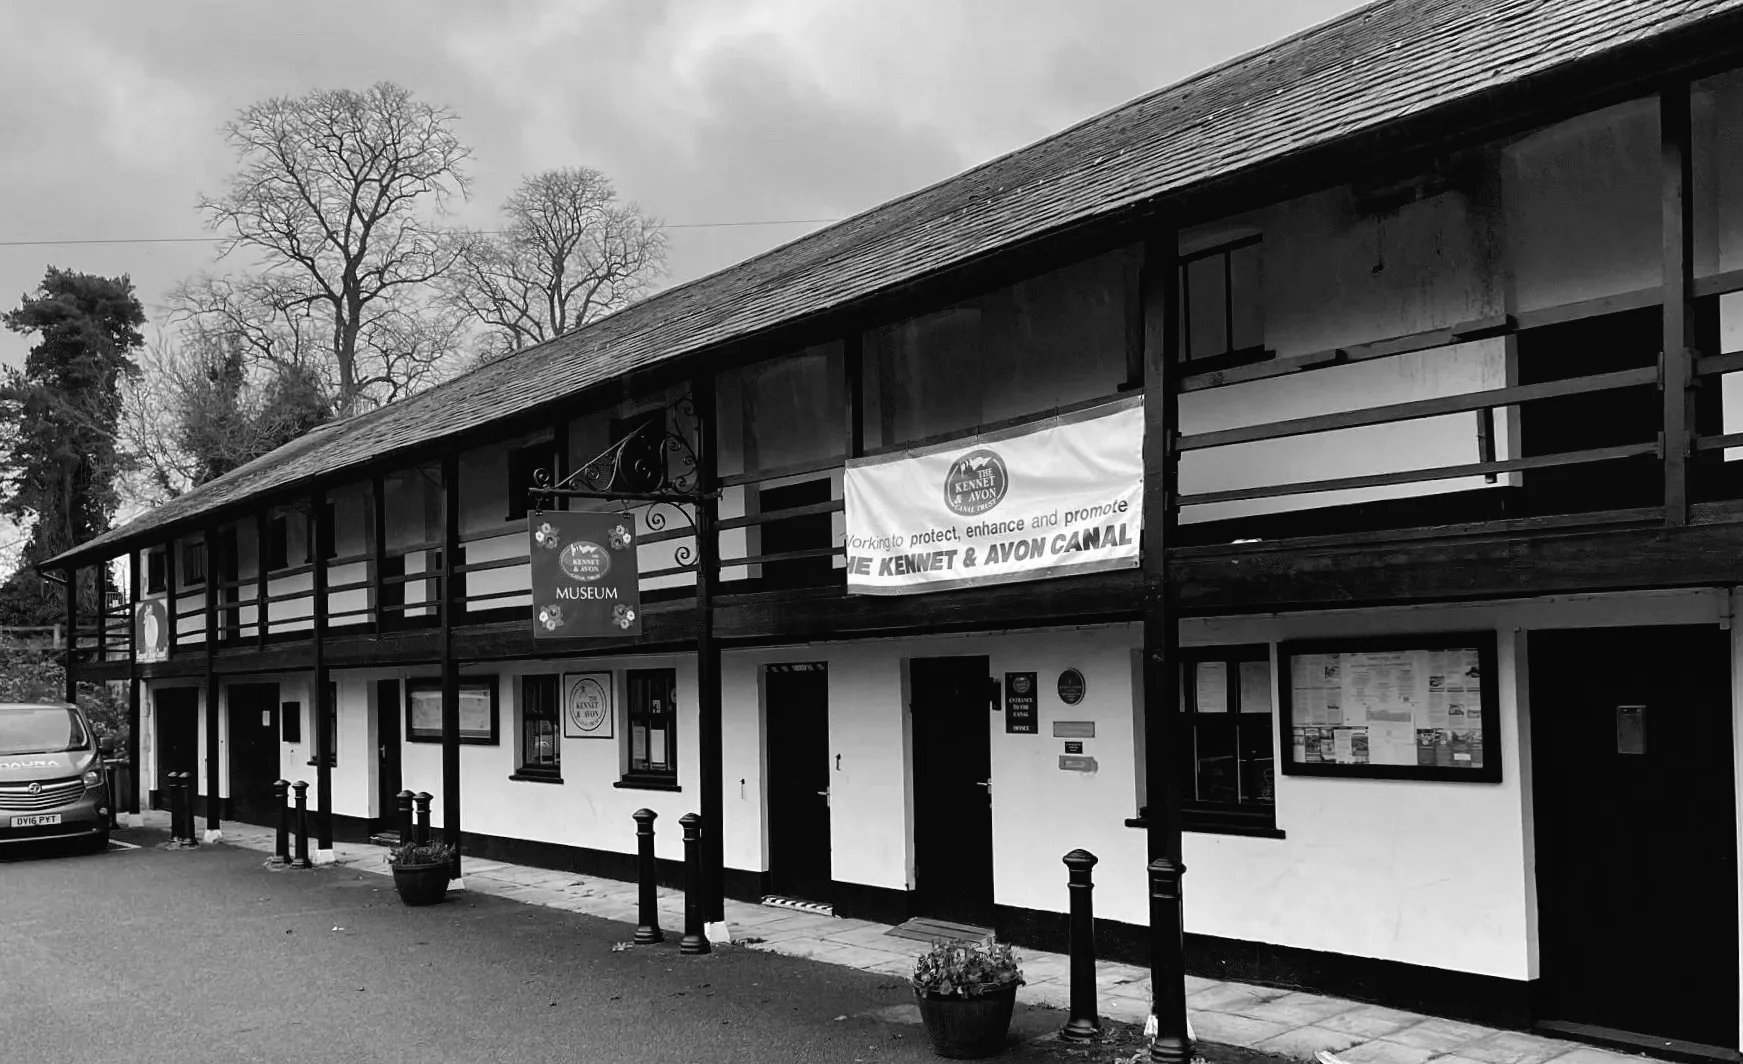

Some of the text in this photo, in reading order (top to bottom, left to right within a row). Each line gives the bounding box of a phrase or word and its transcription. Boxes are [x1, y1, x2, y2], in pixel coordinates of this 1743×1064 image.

[977, 468, 994, 479] THE
[955, 476, 995, 493] KENNET
[953, 487, 996, 504] & AVON
[976, 499, 997, 512] TRUST
[891, 533, 904, 548] to
[910, 526, 961, 548] protect,
[966, 519, 1025, 538] enhance
[1031, 510, 1058, 529] and
[1064, 499, 1128, 527] promote
[878, 550, 958, 577] KENNET
[963, 547, 977, 568] &
[984, 537, 1047, 566] AVON
[1050, 523, 1132, 555] CANAL
[556, 586, 618, 600] MUSEUM
[576, 701, 599, 709] KENNET
[585, 710, 599, 718] AVON
[38, 815, 56, 824] PYT
